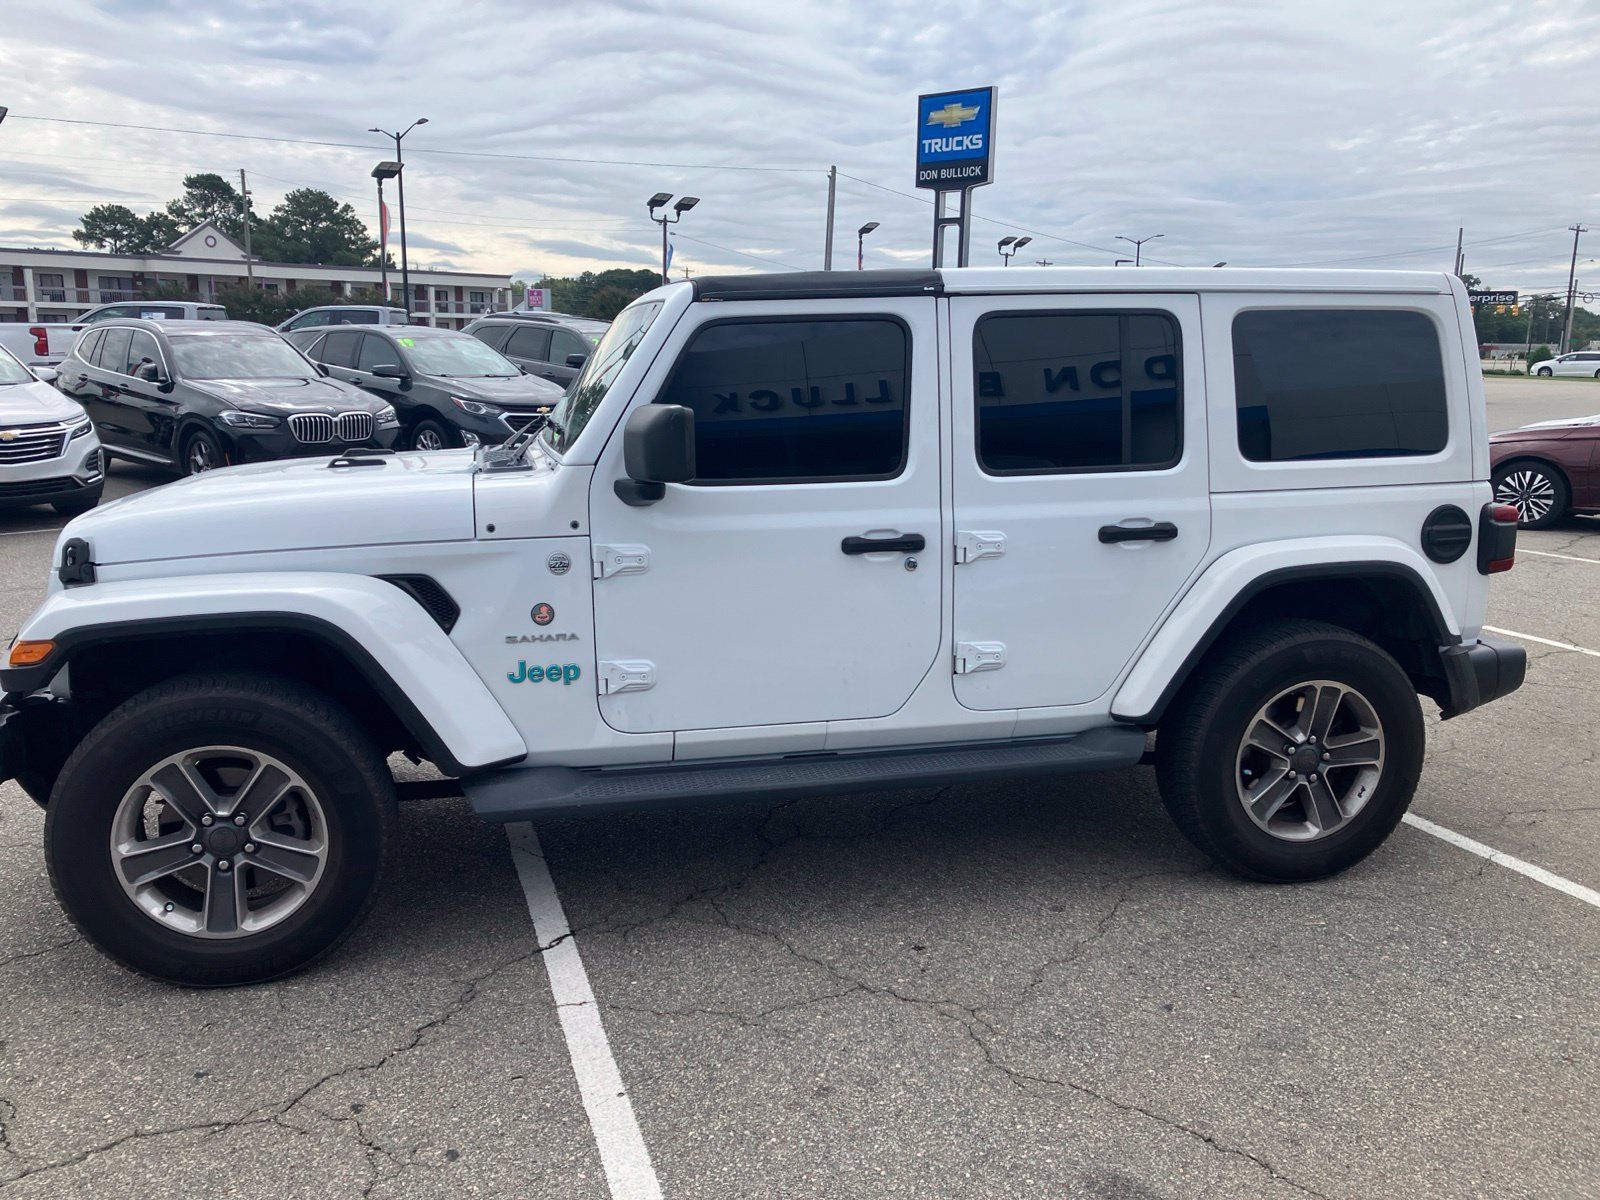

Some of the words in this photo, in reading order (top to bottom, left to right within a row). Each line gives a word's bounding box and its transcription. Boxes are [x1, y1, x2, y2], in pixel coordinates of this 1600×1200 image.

[922, 134, 982, 153] TRUCKS
[920, 170, 938, 180] DON
[940, 166, 981, 178] BULLUCK
[505, 633, 579, 644] SAHARA
[506, 659, 581, 685] Jeep
